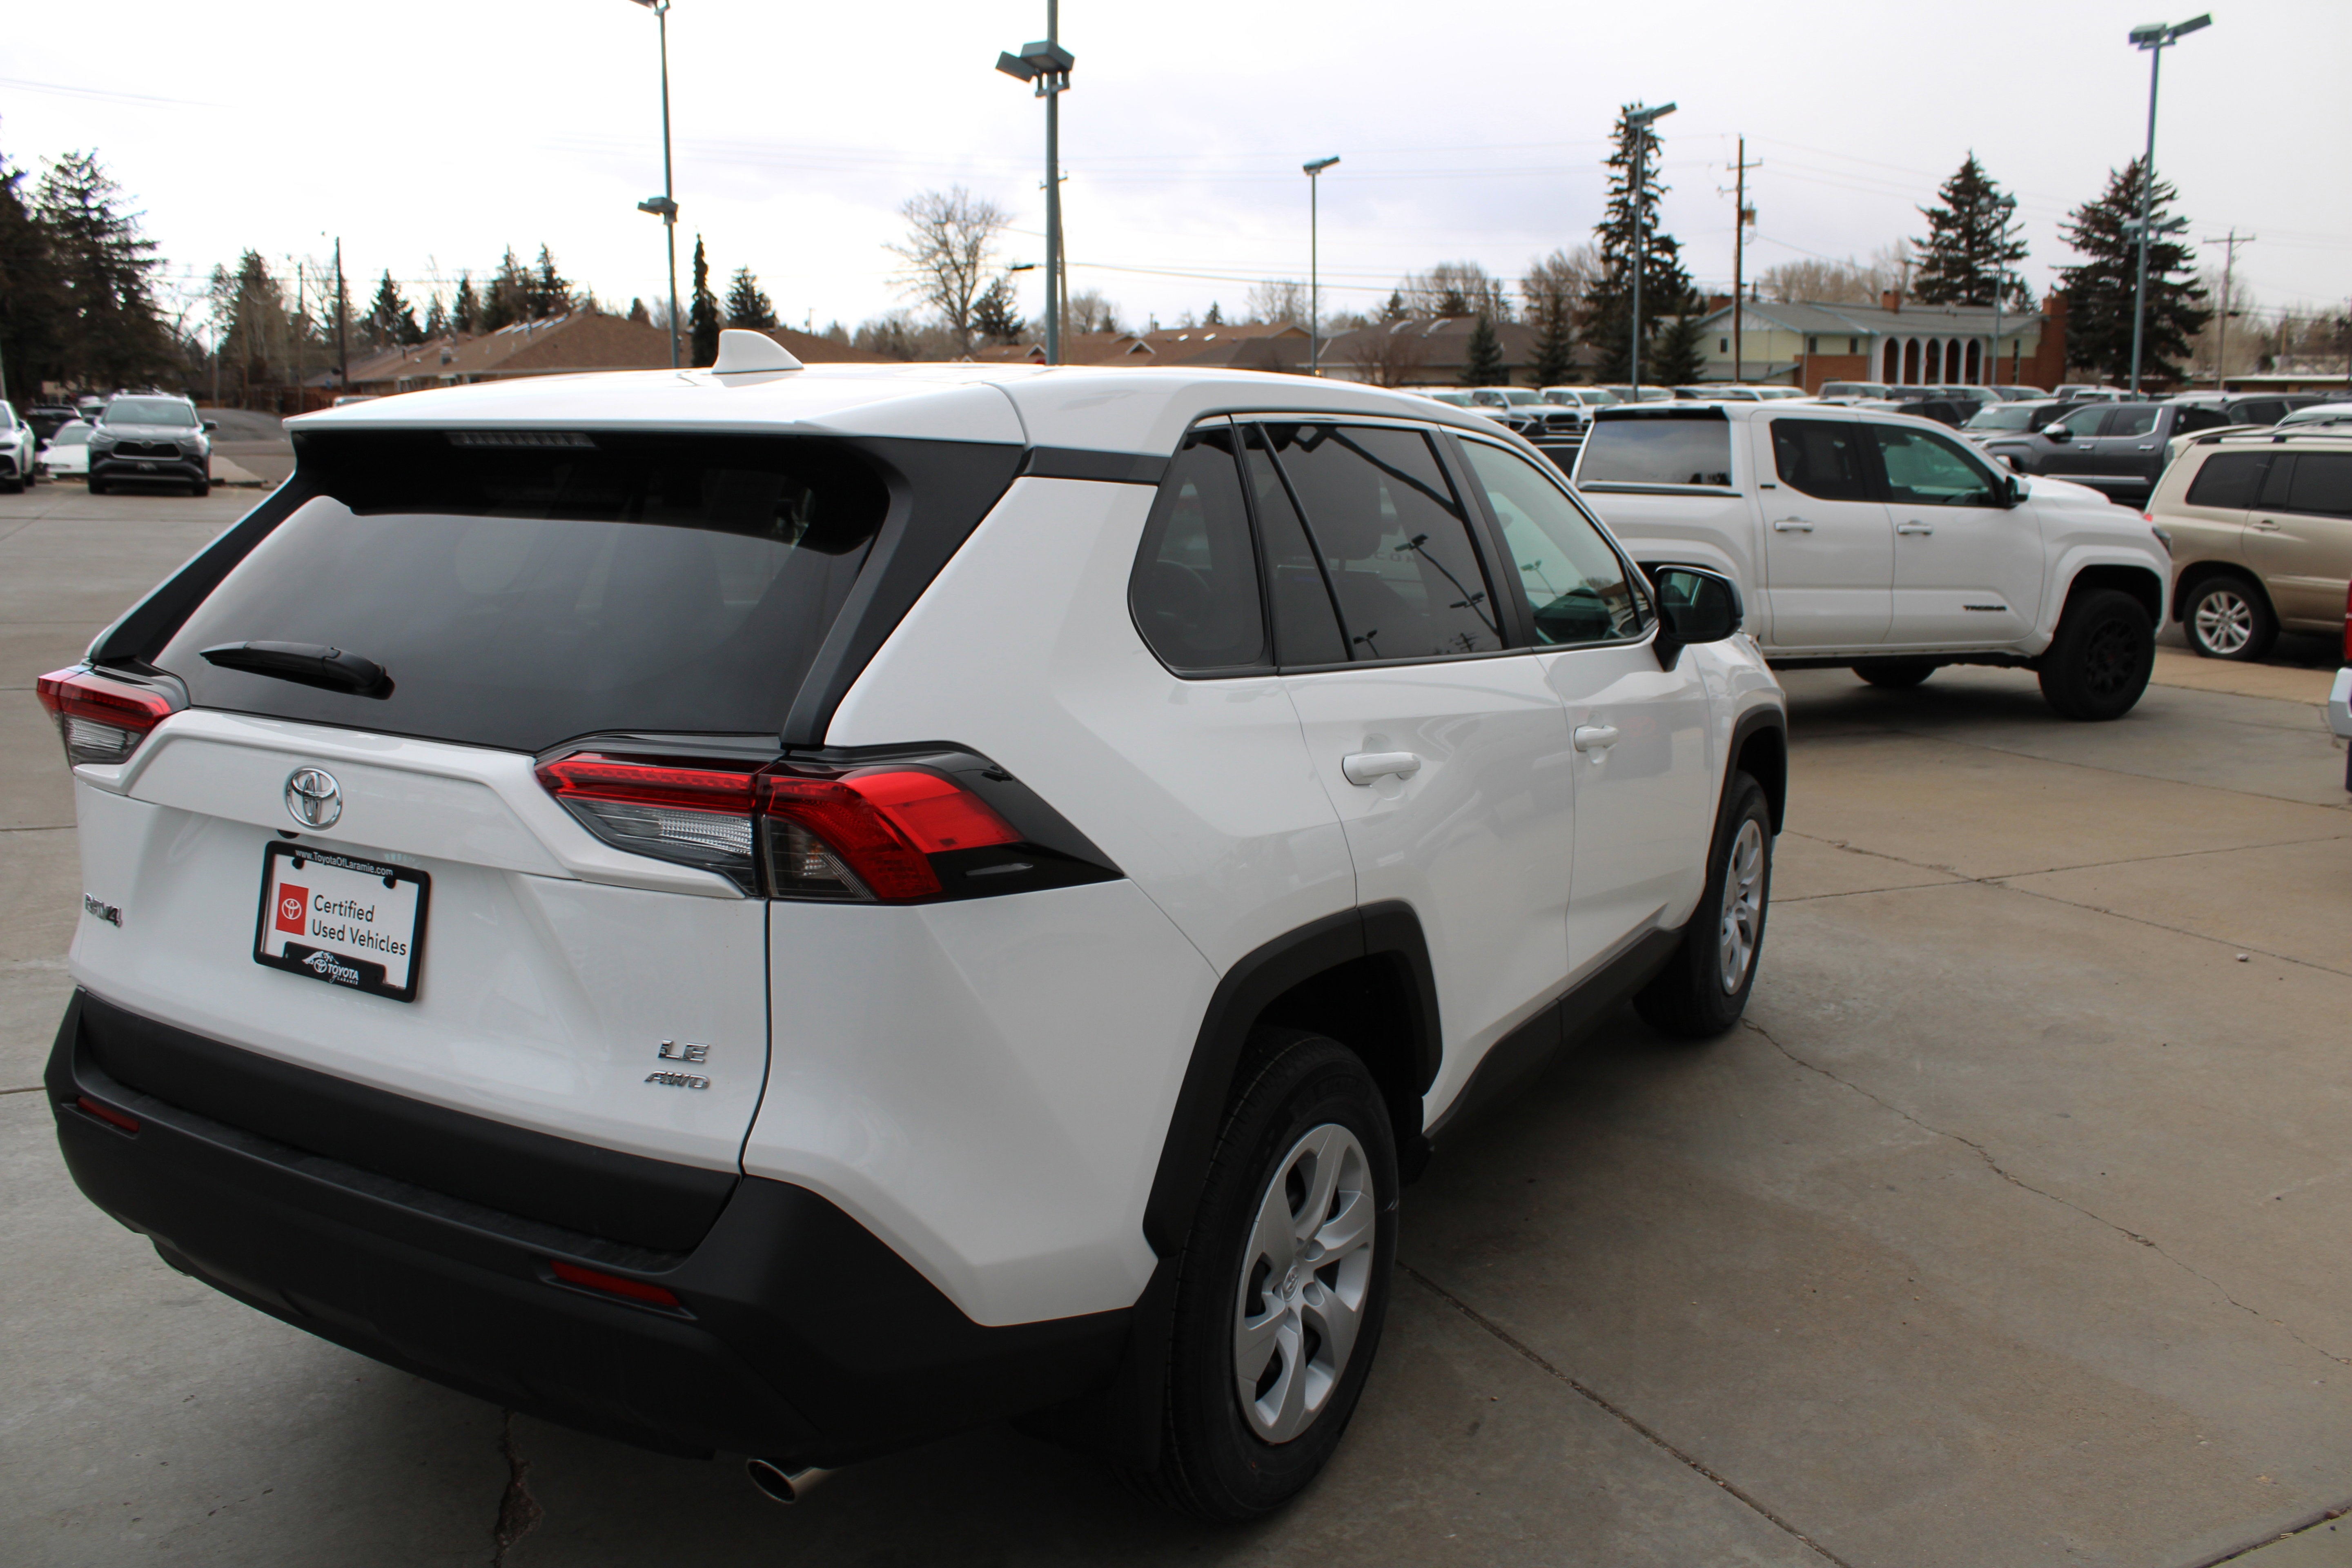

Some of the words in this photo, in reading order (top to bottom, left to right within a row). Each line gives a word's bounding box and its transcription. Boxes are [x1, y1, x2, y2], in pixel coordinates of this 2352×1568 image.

[295, 850, 393, 875] www.ToyotaOfLaramie.com
[314, 894, 375, 922] Certified
[312, 919, 345, 941] Used
[350, 927, 407, 956] Vehicles
[328, 964, 359, 980] TOYOTA
[657, 1040, 709, 1063] LE
[644, 1070, 710, 1089] AWD
